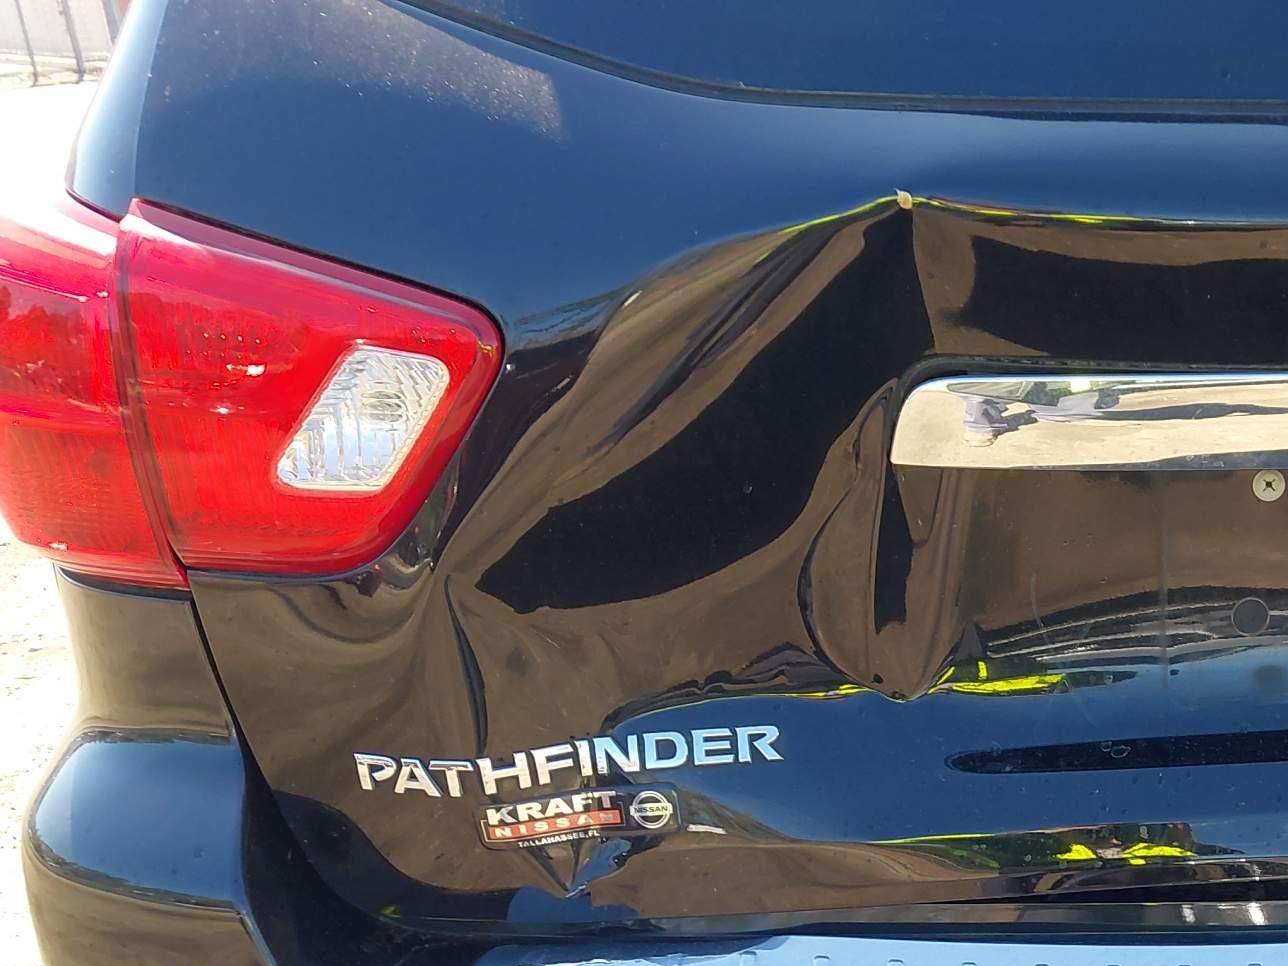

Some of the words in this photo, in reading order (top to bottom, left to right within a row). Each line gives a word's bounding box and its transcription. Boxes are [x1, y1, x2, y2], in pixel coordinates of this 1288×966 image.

[353, 724, 784, 798] PATHFINDER
[485, 791, 616, 825] KRAFT
[634, 804, 669, 814] NISSAN
[494, 812, 616, 839] NISSAN
